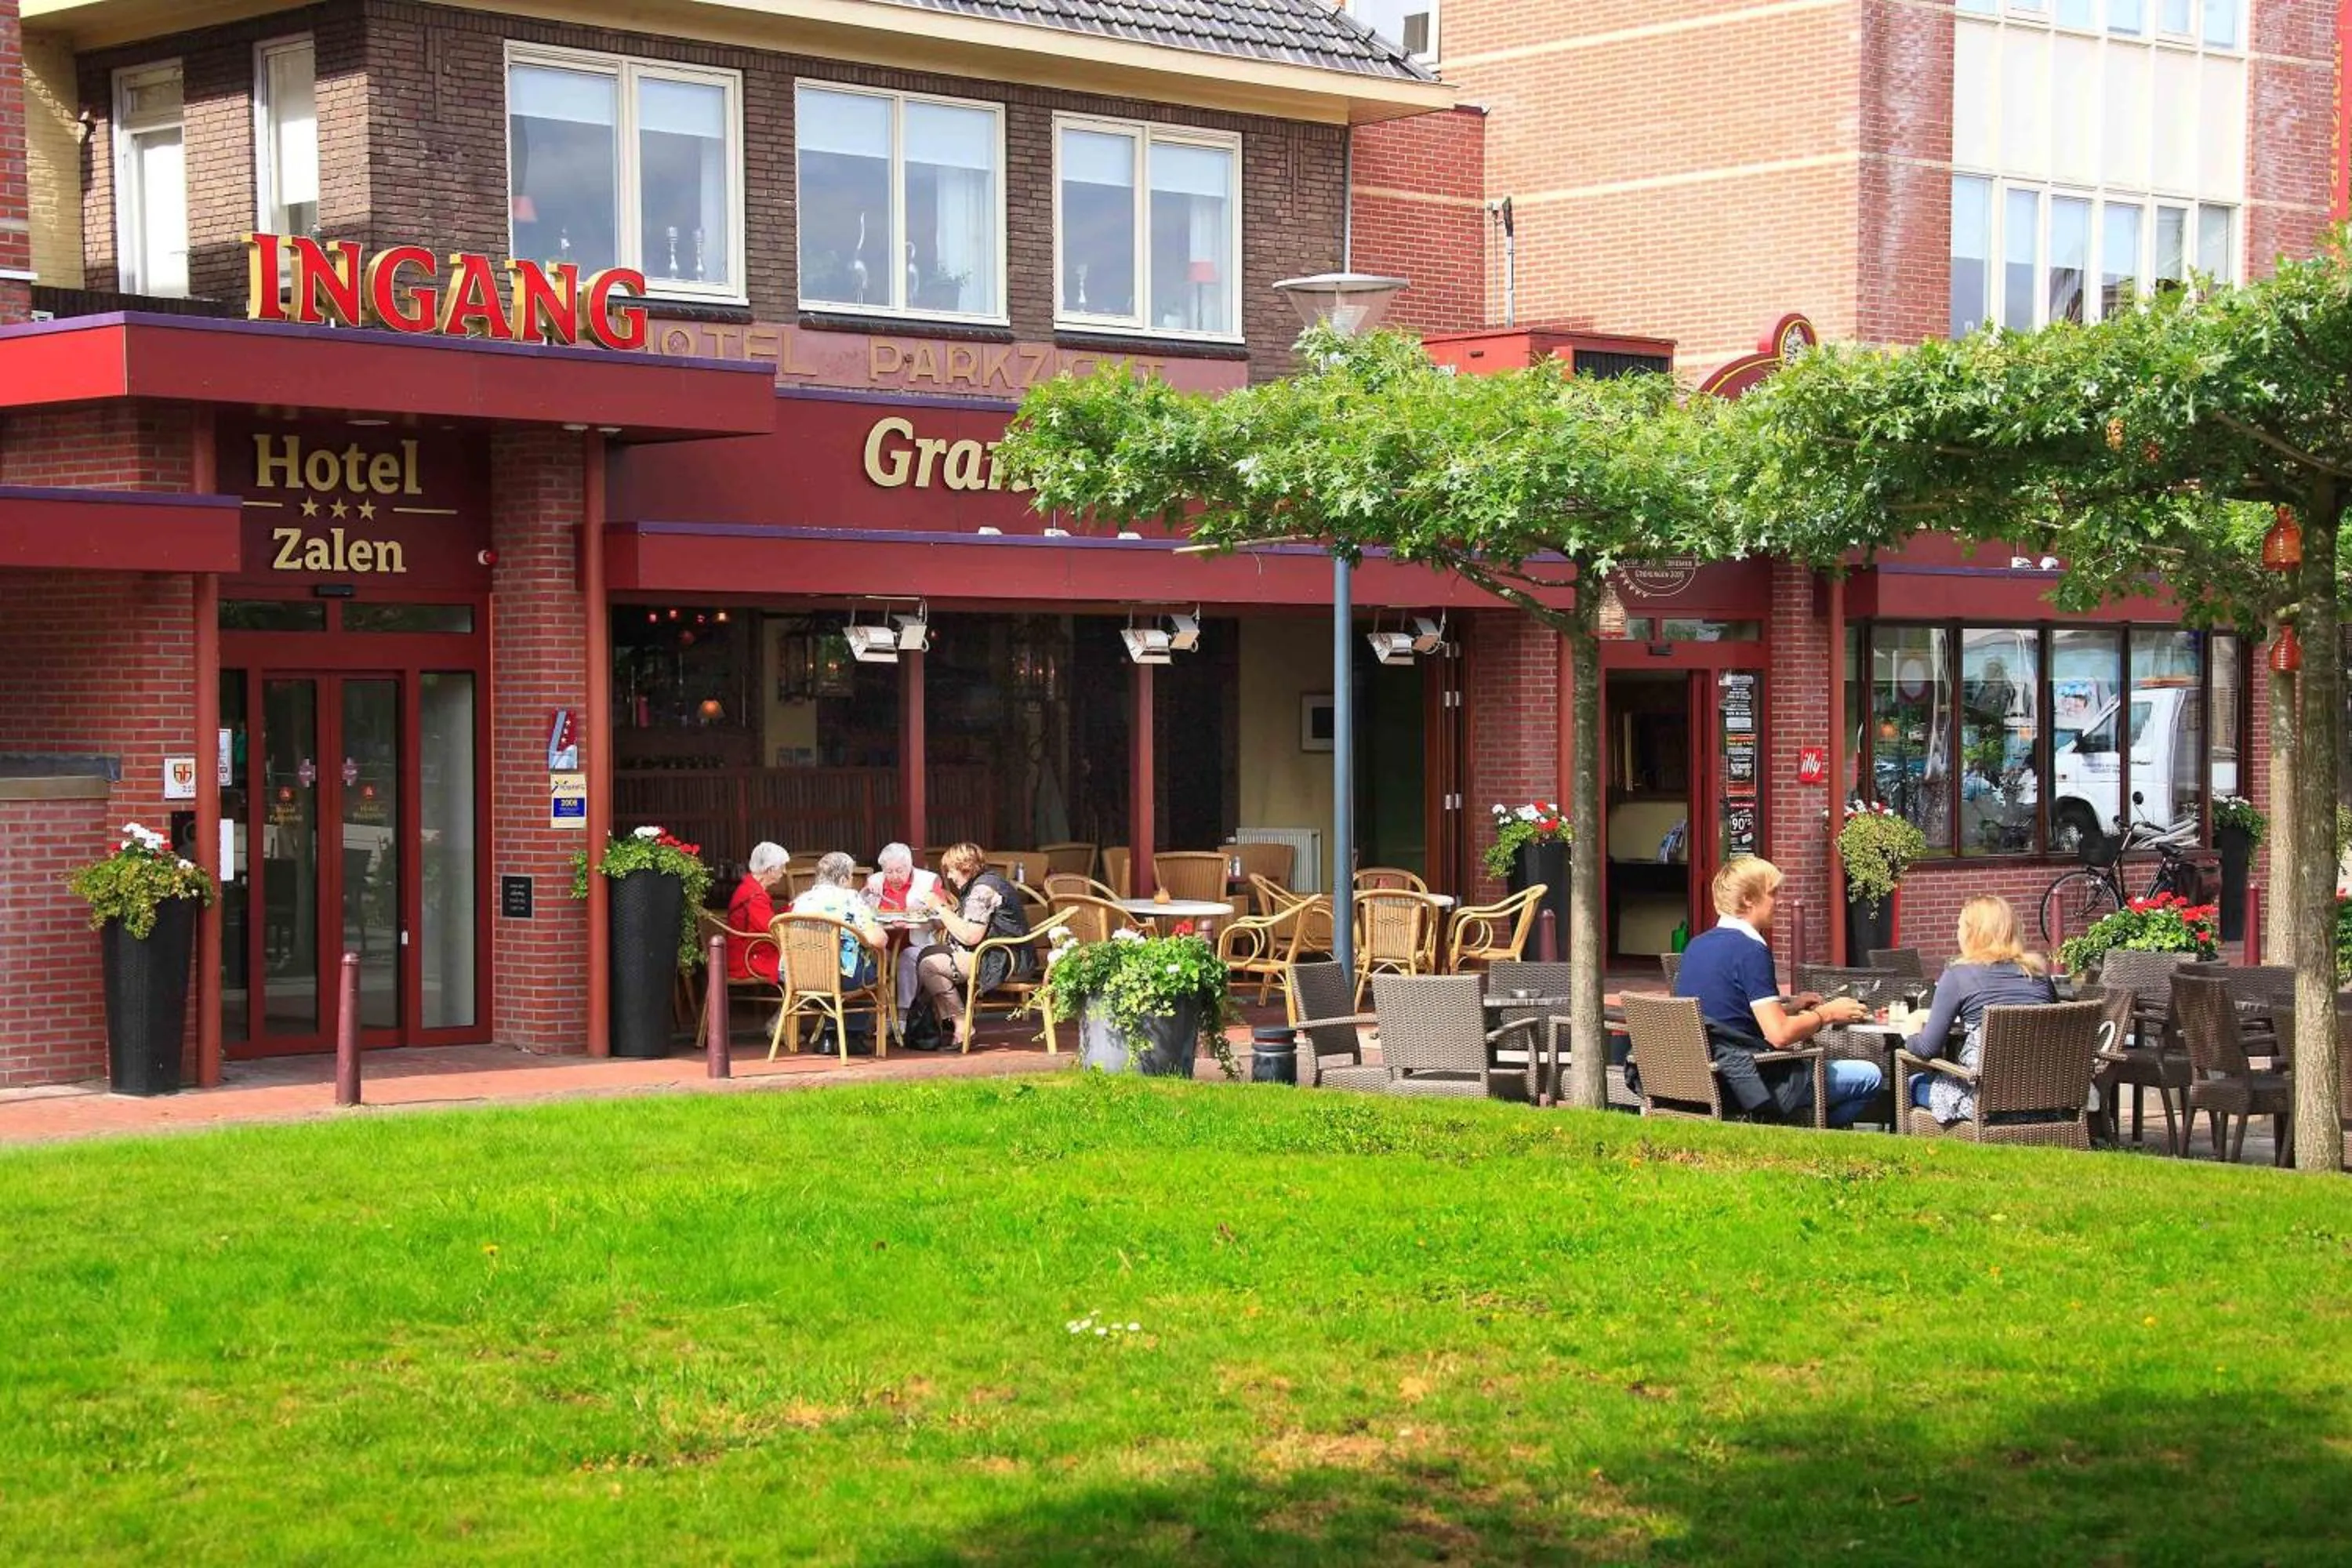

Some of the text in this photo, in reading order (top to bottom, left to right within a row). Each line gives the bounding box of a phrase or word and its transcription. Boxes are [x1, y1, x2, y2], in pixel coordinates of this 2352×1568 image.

[241, 233, 648, 350] INGANG
[644, 319, 818, 377] OTEL
[253, 434, 423, 495] Hotel
[272, 527, 407, 573] Zalen
[1802, 752, 1821, 778] illy
